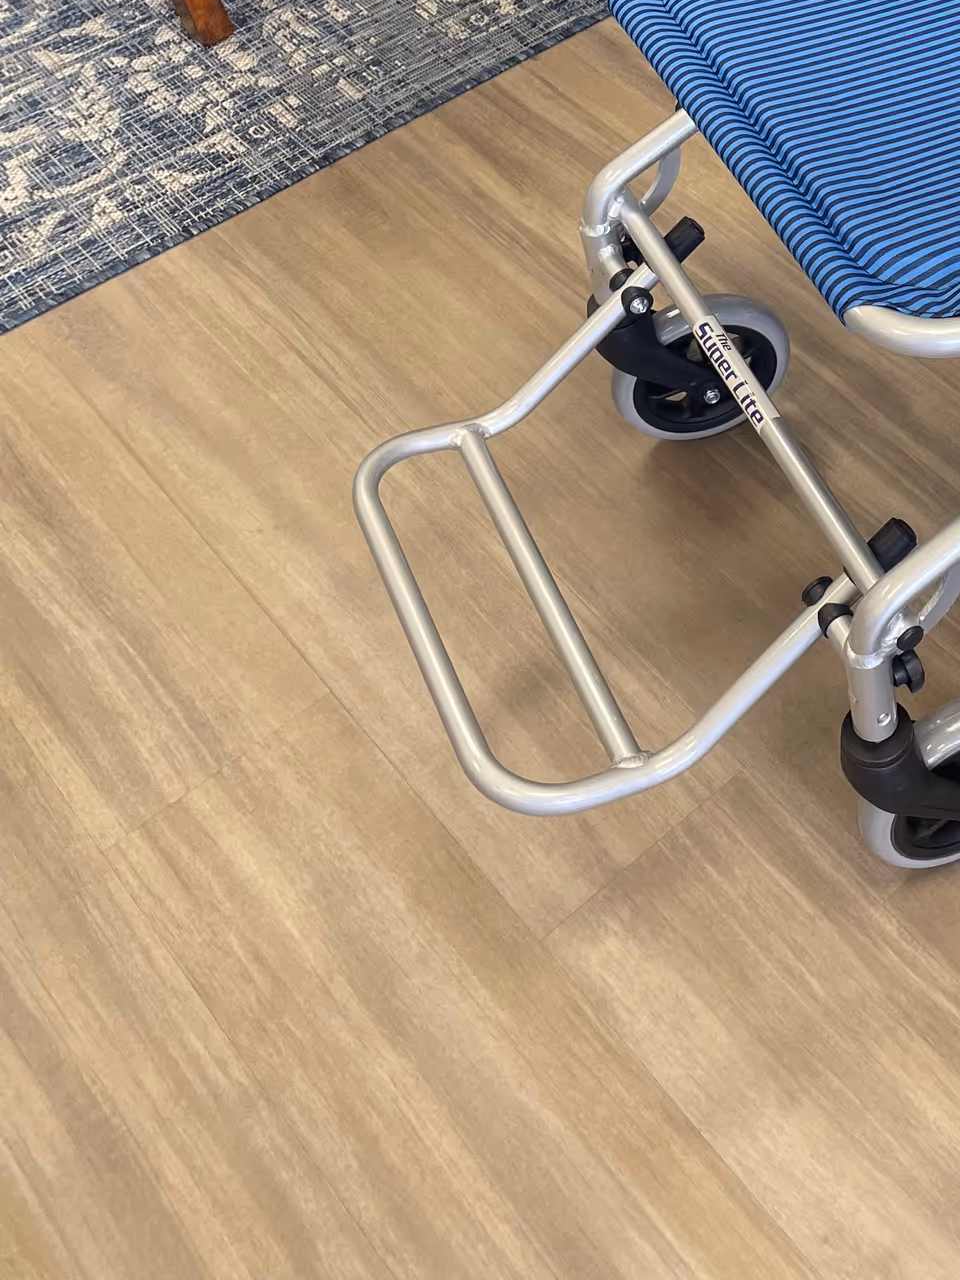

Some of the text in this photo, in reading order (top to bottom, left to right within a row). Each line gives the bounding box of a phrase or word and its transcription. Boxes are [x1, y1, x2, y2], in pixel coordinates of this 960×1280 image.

[715, 331, 733, 352] The
[698, 322, 765, 425] Super Lite
